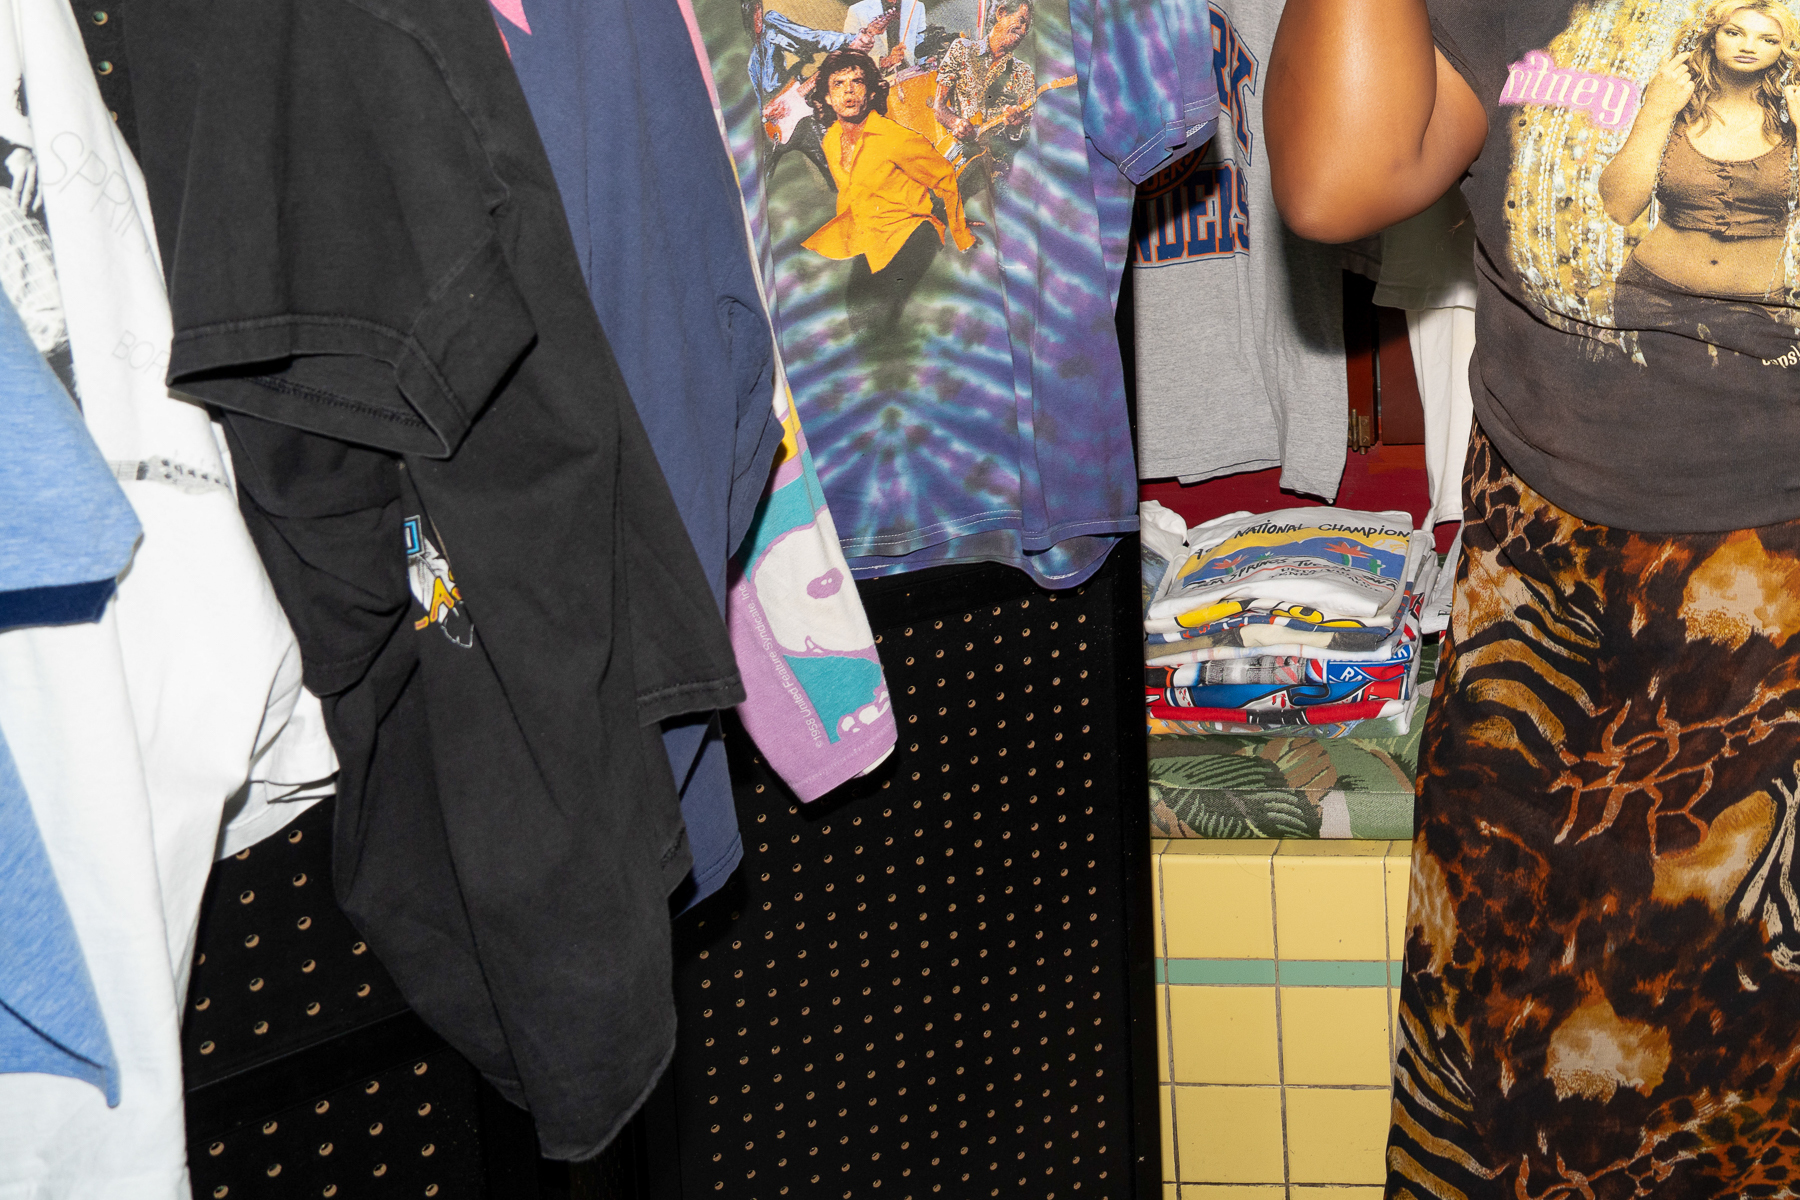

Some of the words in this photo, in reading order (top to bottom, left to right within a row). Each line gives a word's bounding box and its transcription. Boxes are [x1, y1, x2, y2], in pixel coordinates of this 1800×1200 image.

[1501, 55, 1631, 126] ritney
[769, 651, 793, 688] Feature
[788, 687, 812, 718] United
